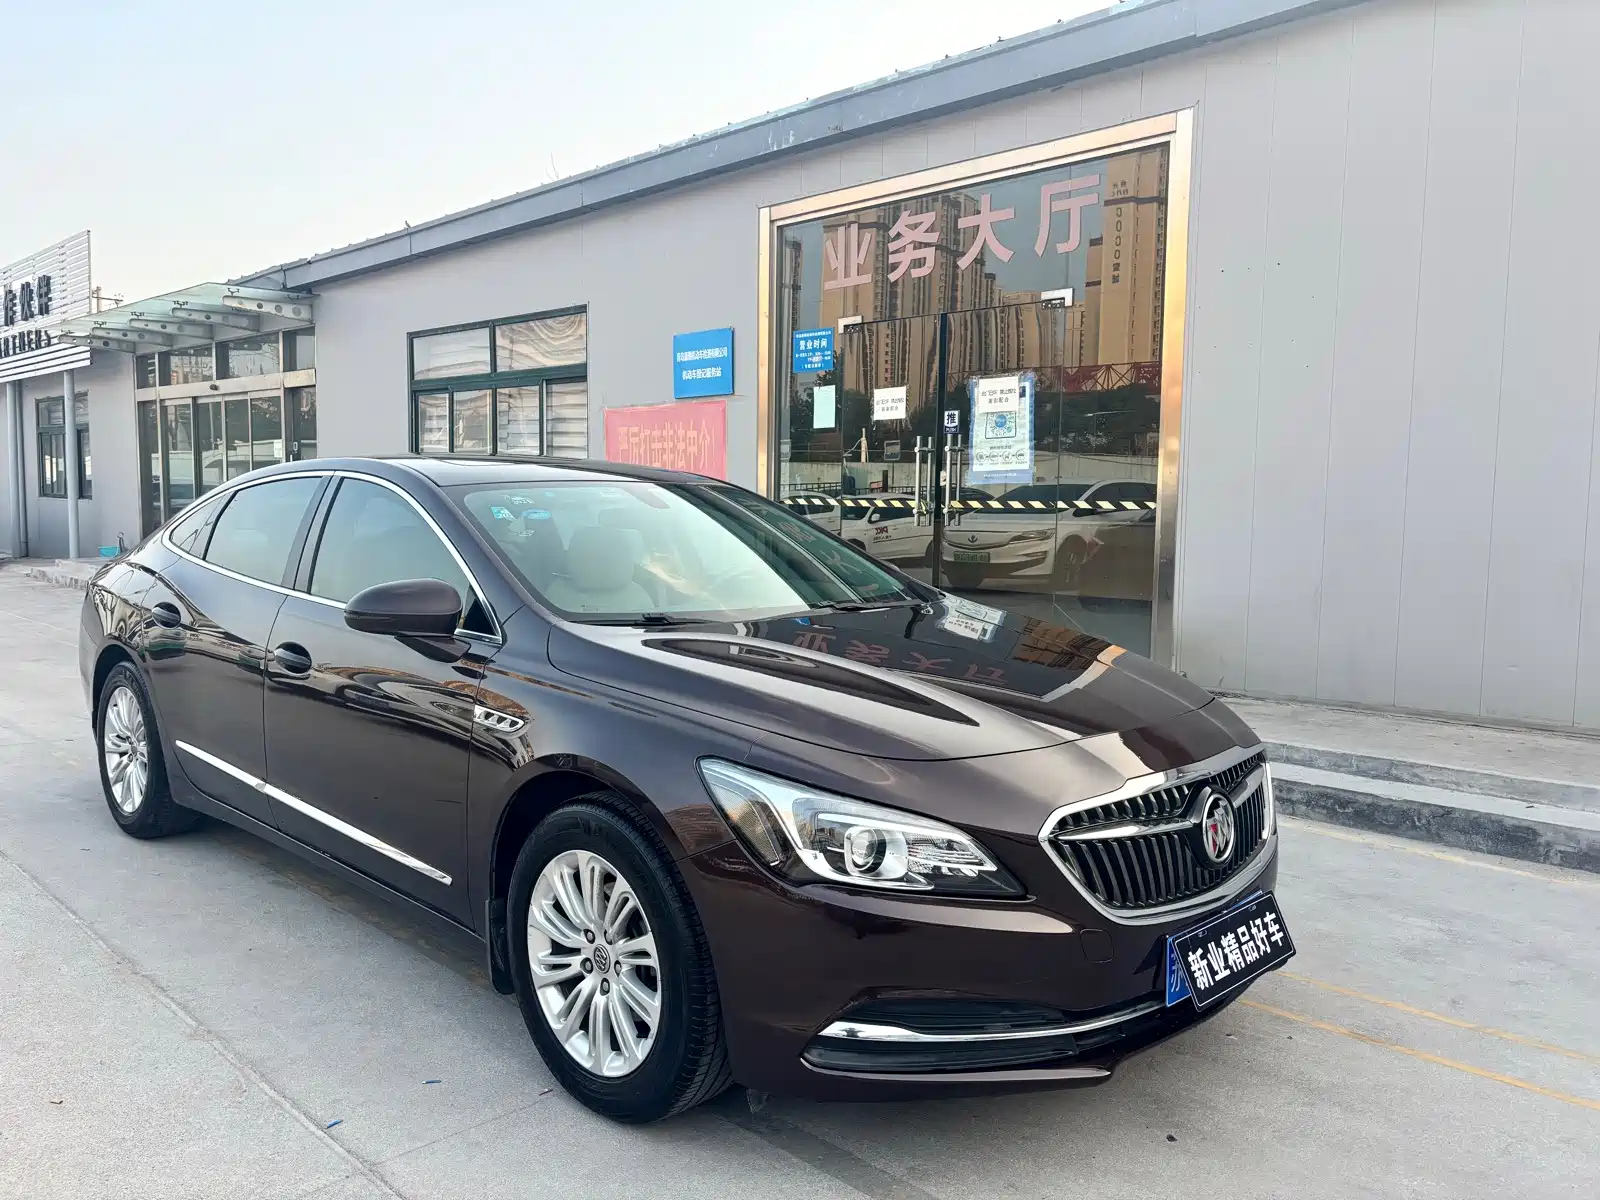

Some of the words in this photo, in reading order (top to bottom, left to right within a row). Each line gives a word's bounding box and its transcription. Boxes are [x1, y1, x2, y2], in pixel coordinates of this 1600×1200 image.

[823, 173, 1101, 291] 业务大厅
[799, 338, 828, 351] 营业时间
[682, 366, 722, 380] 机动车登记服务站
[946, 412, 956, 425] 推
[1187, 911, 1284, 990] 新业精品好车
